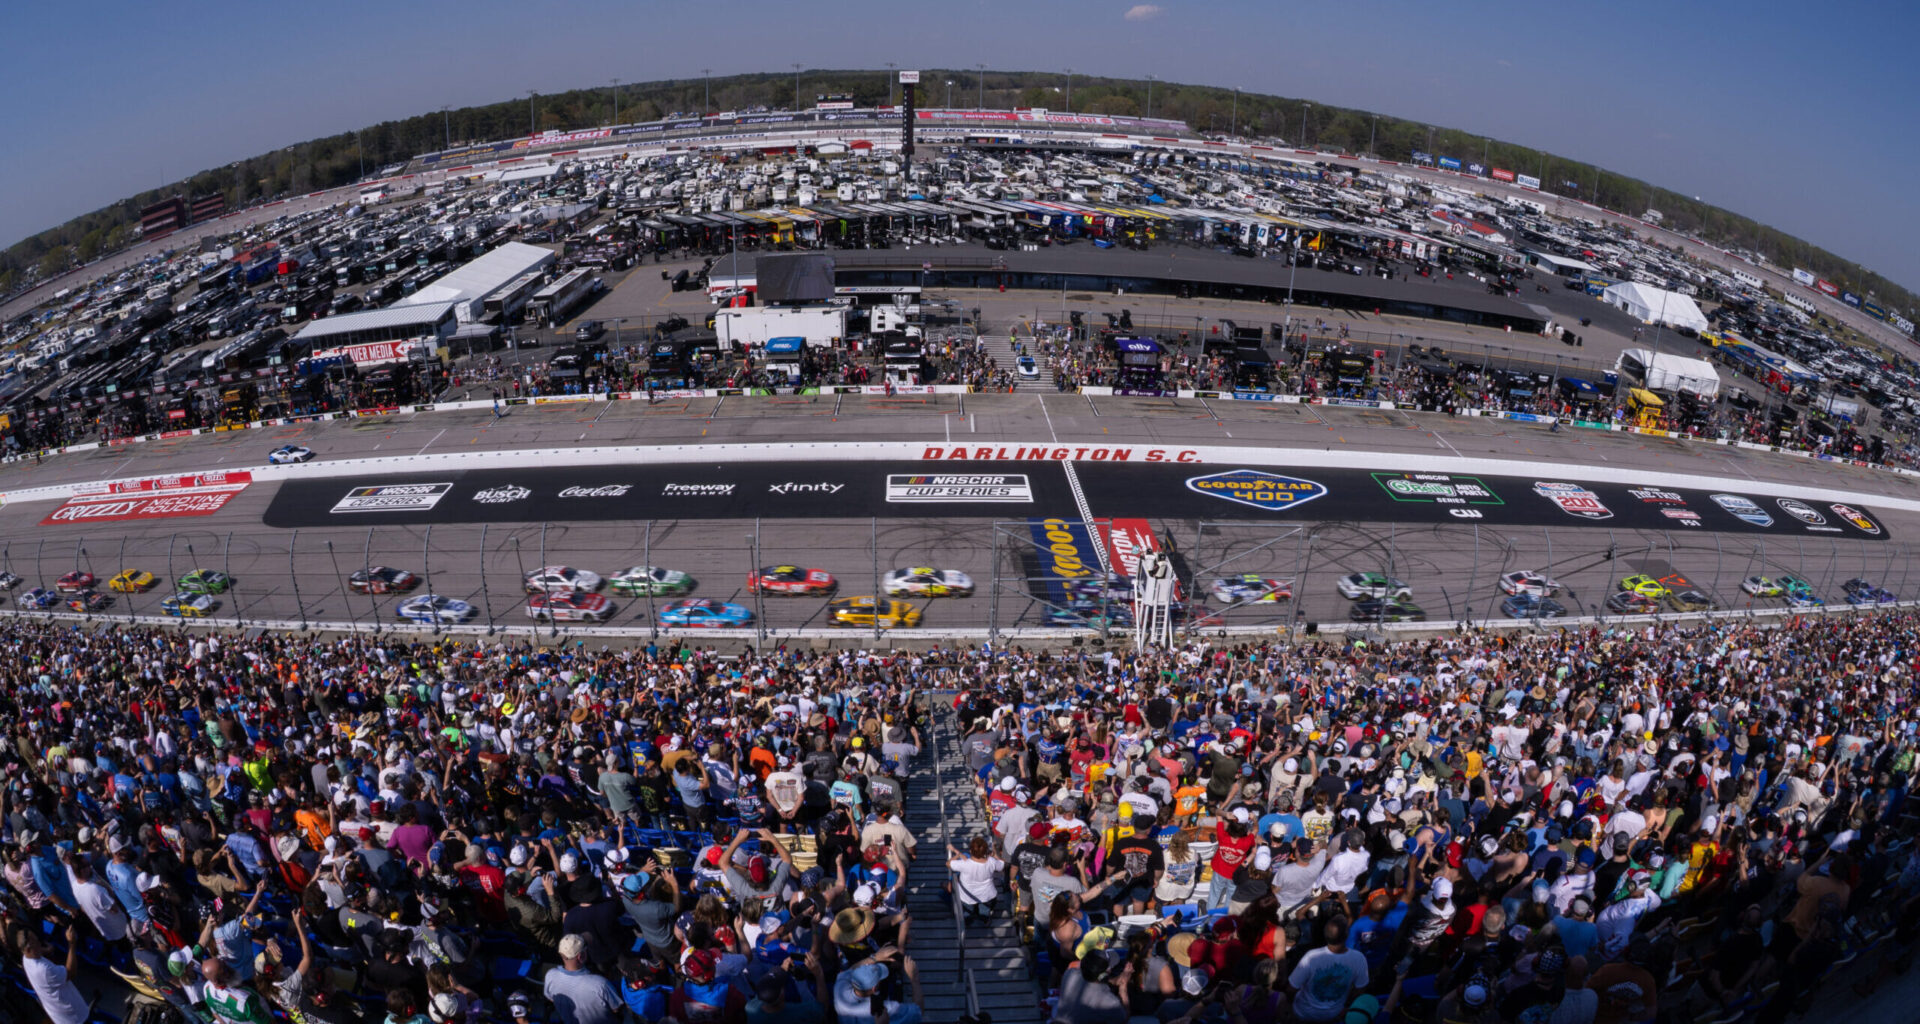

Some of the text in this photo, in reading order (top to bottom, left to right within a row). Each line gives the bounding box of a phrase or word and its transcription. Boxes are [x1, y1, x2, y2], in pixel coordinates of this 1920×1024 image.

[1045, 115, 1097, 125] COOK OUT
[528, 130, 607, 147] COOK OUT
[1469, 163, 1483, 174] ally
[1890, 312, 1915, 329] COOK
[1897, 321, 1915, 334] OUT
[369, 343, 394, 359] MEDIA
[1128, 343, 1151, 351] ally
[922, 446, 1203, 464] DARLINGTON S.C.
[932, 475, 1005, 486] NASCAR
[1414, 473, 1450, 481] NASCAR
[376, 485, 436, 496] NASCAR
[664, 483, 736, 492] Freeway
[768, 482, 845, 495] xfinity
[1197, 480, 1313, 490] GOODYEAR
[472, 488, 532, 501] BUSCH
[905, 487, 1011, 496] CUP SERIES
[1233, 490, 1294, 501] 400
[1457, 489, 1490, 497] PARTS
[148, 493, 231, 506] NICOTINE
[349, 496, 427, 507] CUP SERIES
[1557, 496, 1599, 508] 200
[51, 499, 148, 521] GRIZZLY
[139, 502, 226, 514] POUCHES
